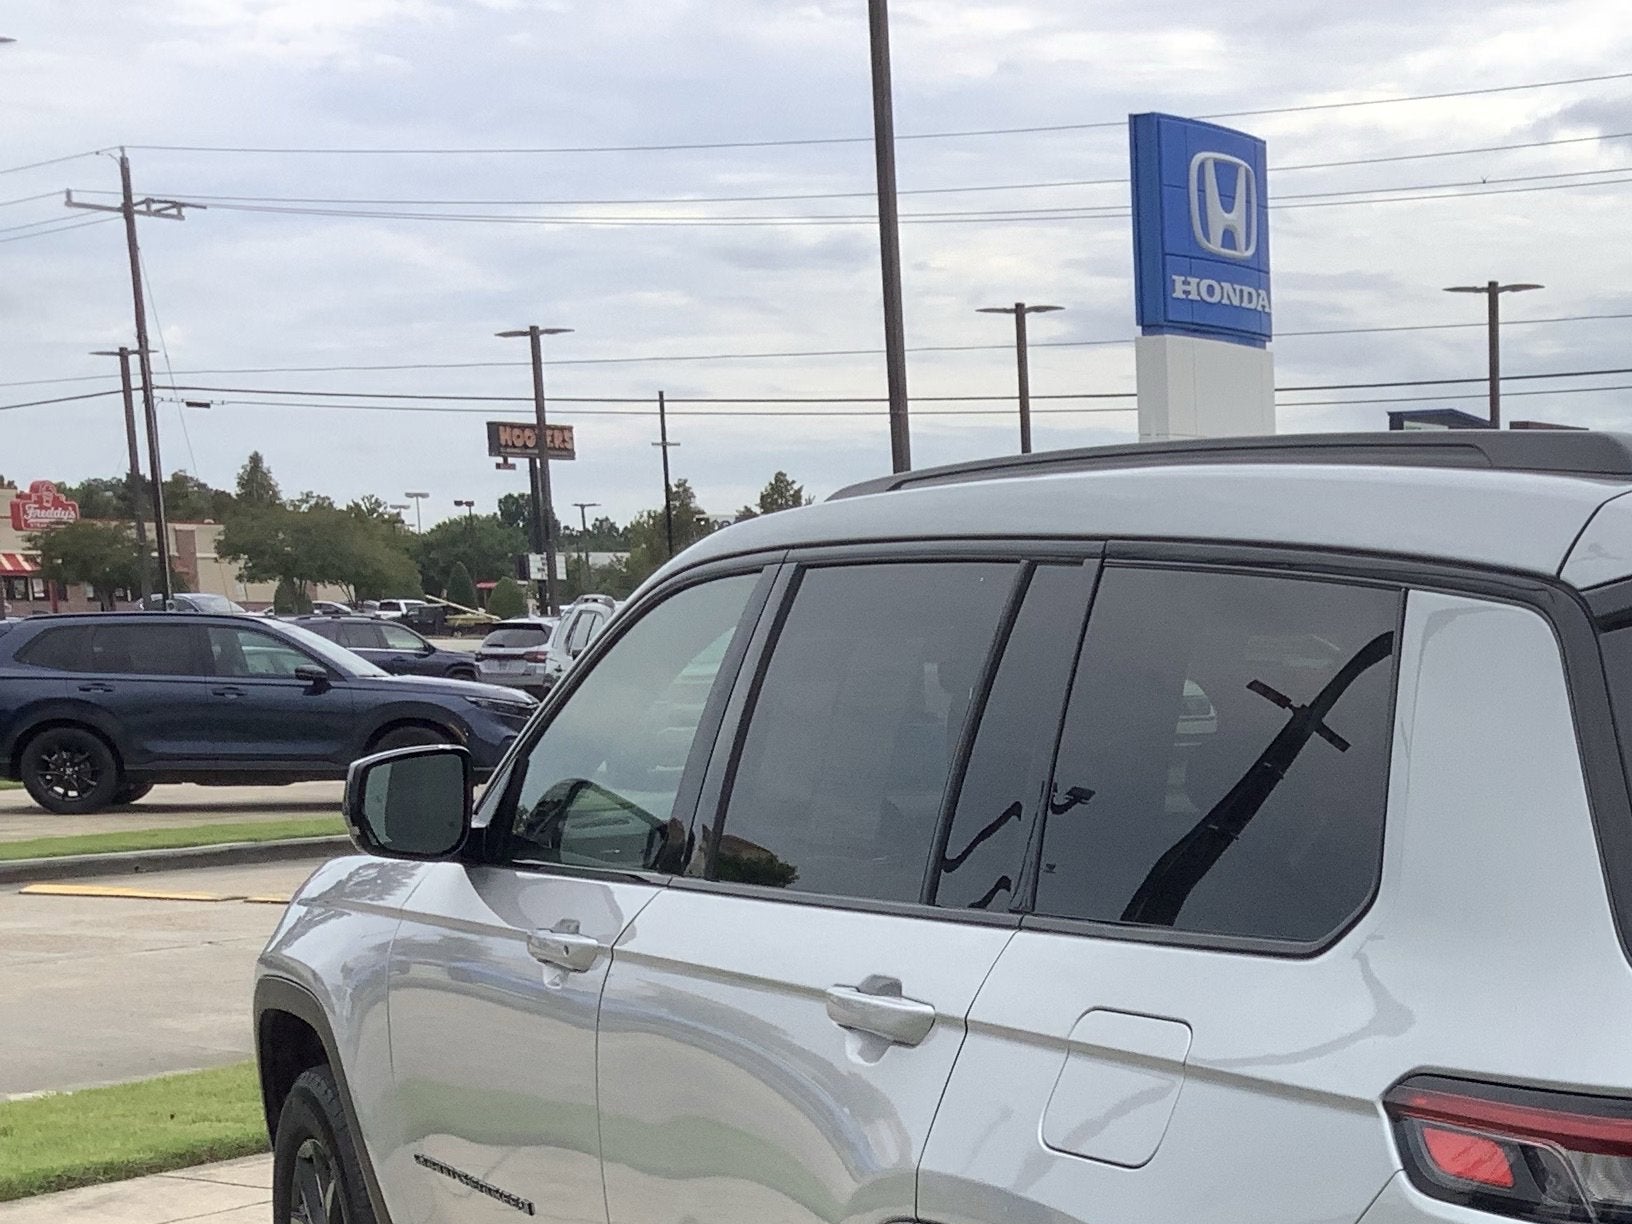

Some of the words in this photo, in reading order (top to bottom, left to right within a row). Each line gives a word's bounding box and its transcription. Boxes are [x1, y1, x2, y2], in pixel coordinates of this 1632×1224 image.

[1172, 274, 1272, 313] HONDA
[498, 425, 573, 450] HOOERS
[24, 503, 77, 519] Freddy's
